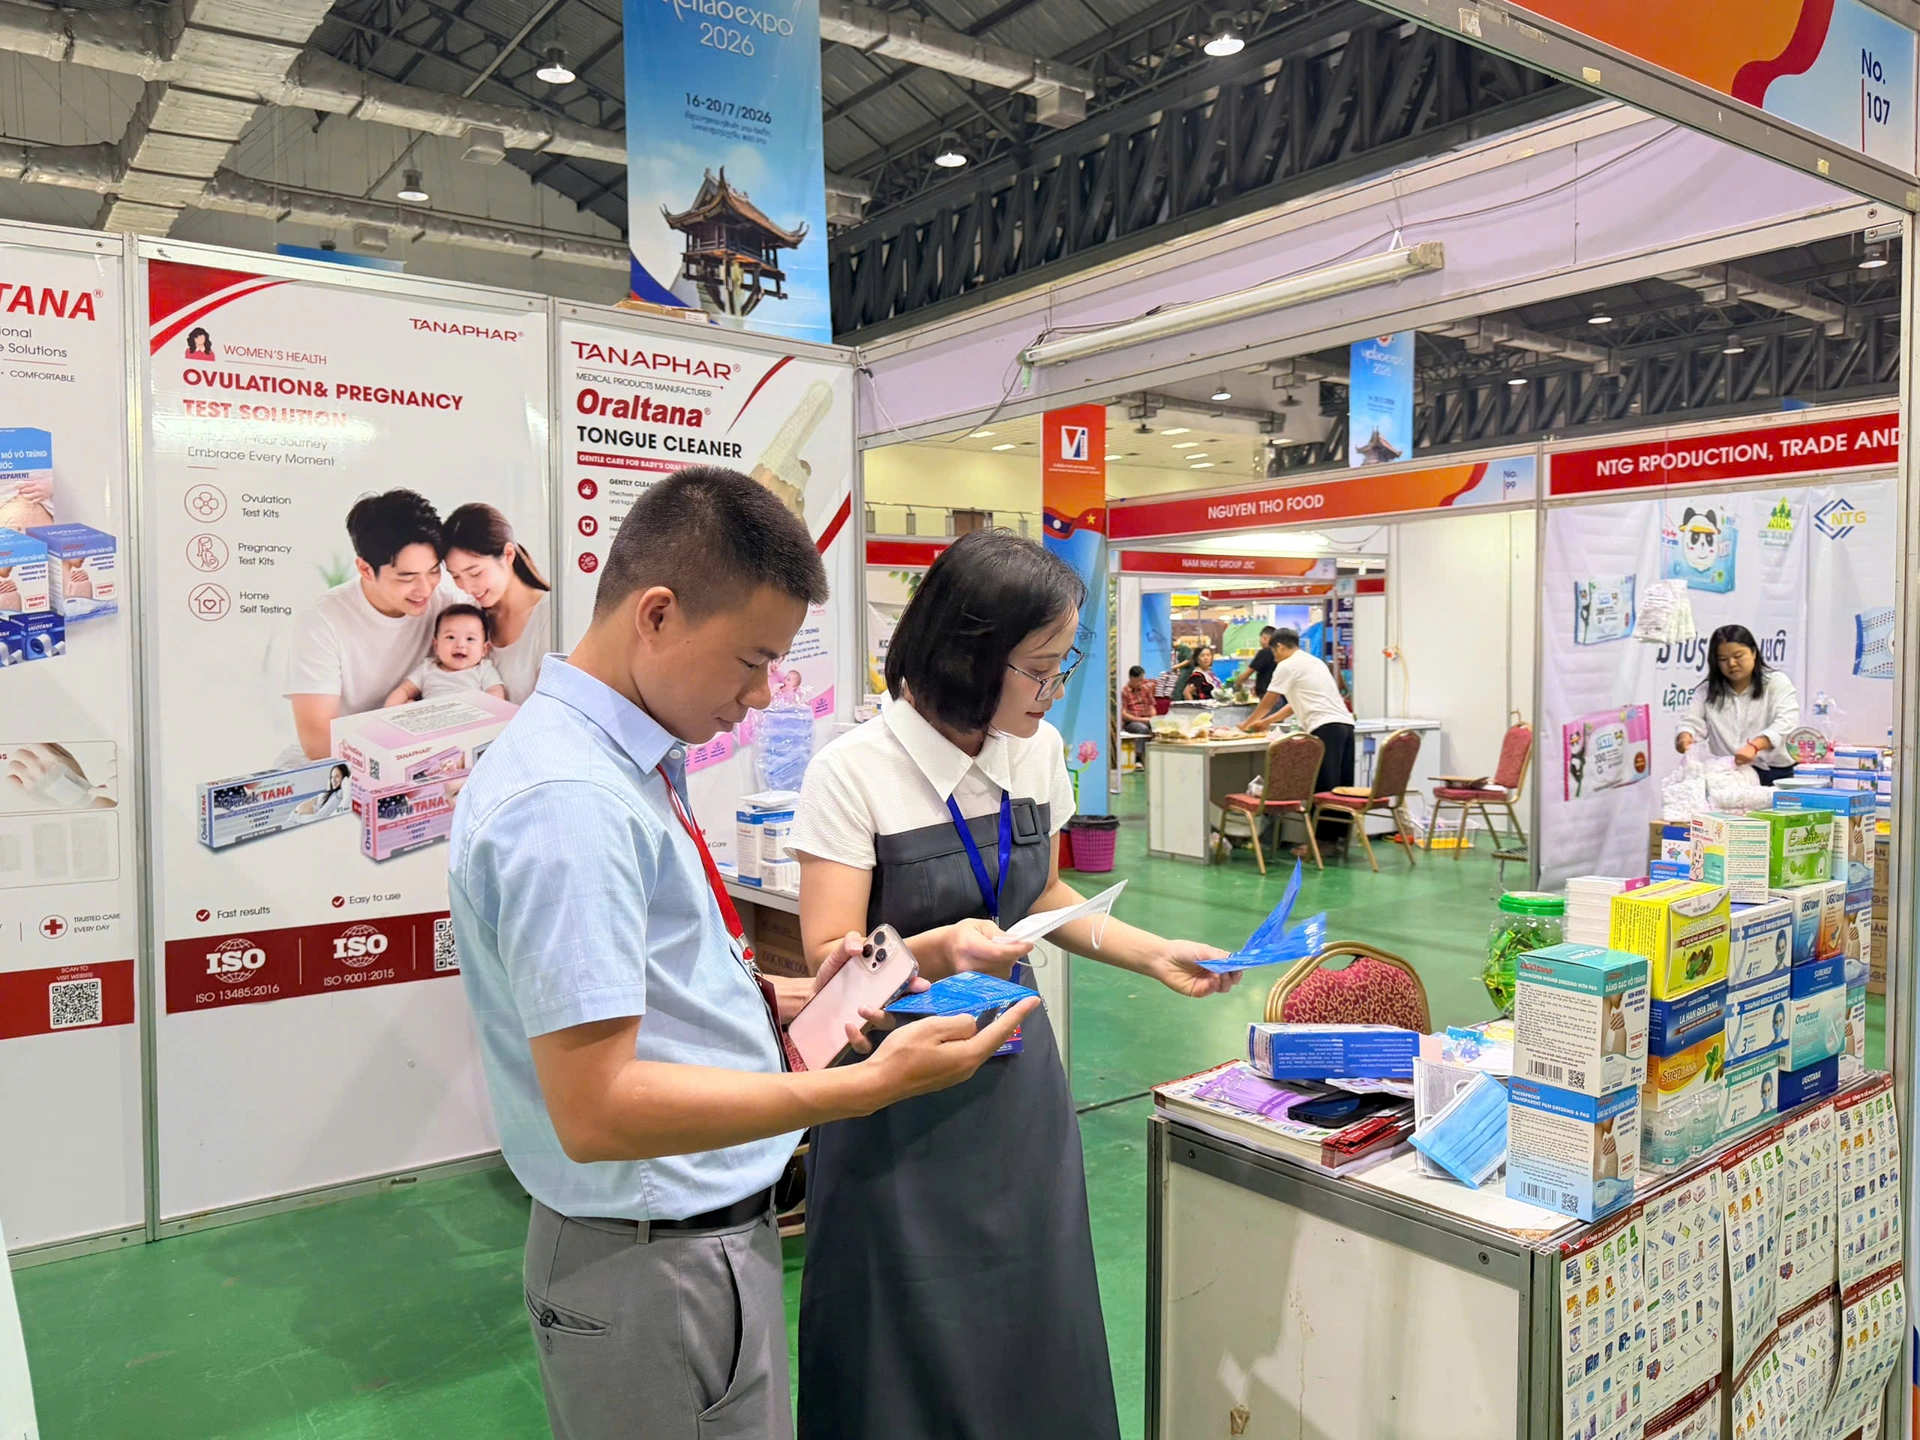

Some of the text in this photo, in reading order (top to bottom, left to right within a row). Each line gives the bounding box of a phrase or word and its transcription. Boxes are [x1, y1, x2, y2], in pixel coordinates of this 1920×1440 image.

[700, 22, 755, 57] 2026
[1862, 48, 1886, 84] No.
[685, 92, 772, 124] 16-20/7/2026
[1867, 92, 1890, 125] 107
[8, 343, 68, 358] Solutions
[286, 352, 327, 365] HEALTH
[10, 369, 76, 383] COMFORTABLE
[183, 368, 463, 411] OVULATION& PREGNANCY
[576, 372, 712, 398] MEDICAL PRODUCTS MANUFACTURER
[183, 399, 232, 419] TEST
[280, 437, 327, 451] Journey
[577, 425, 742, 459] TONGUE CLEANER
[188, 447, 334, 467] Embrace Every Moment
[579, 455, 605, 464] GENTLE
[625, 459, 639, 467] FOR
[1597, 458, 1634, 476] NTG
[1638, 442, 1774, 472] RPODUCTION,
[1780, 433, 1848, 457] TRADE
[1503, 470, 1518, 479] No.
[609, 479, 633, 487] GENTLY
[1504, 480, 1517, 490] 99
[242, 494, 291, 504] Ovulation
[242, 508, 279, 518] Test Kits
[1208, 494, 1324, 519] NGUYEN THO FOOD
[1832, 514, 1867, 525] NTG
[238, 543, 291, 554] Pregnancy
[239, 556, 274, 565] Test Kits
[1182, 558, 1200, 567] NAM
[1200, 559, 1219, 568] NHAT
[1219, 560, 1242, 569] GROUP
[240, 592, 269, 600] Home
[240, 605, 292, 615] Self Testing
[261, 785, 294, 801] TANA
[415, 796, 445, 813] TANA
[349, 892, 401, 906] Easy to use
[74, 915, 101, 923] TRUSTED
[217, 906, 271, 920] Fast results
[74, 924, 110, 934] EVERY DAY
[333, 933, 388, 959] ISO
[206, 948, 266, 975] ISO
[324, 969, 395, 986] ISO 9001:2015
[195, 984, 280, 1004] ISO 13485:2016
[1707, 1000, 1718, 1013] TANA
[1741, 1037, 1748, 1054] 3
[1511, 1089, 1540, 1100] WATERPROOF
[1552, 1105, 1575, 1115] DRESSING
